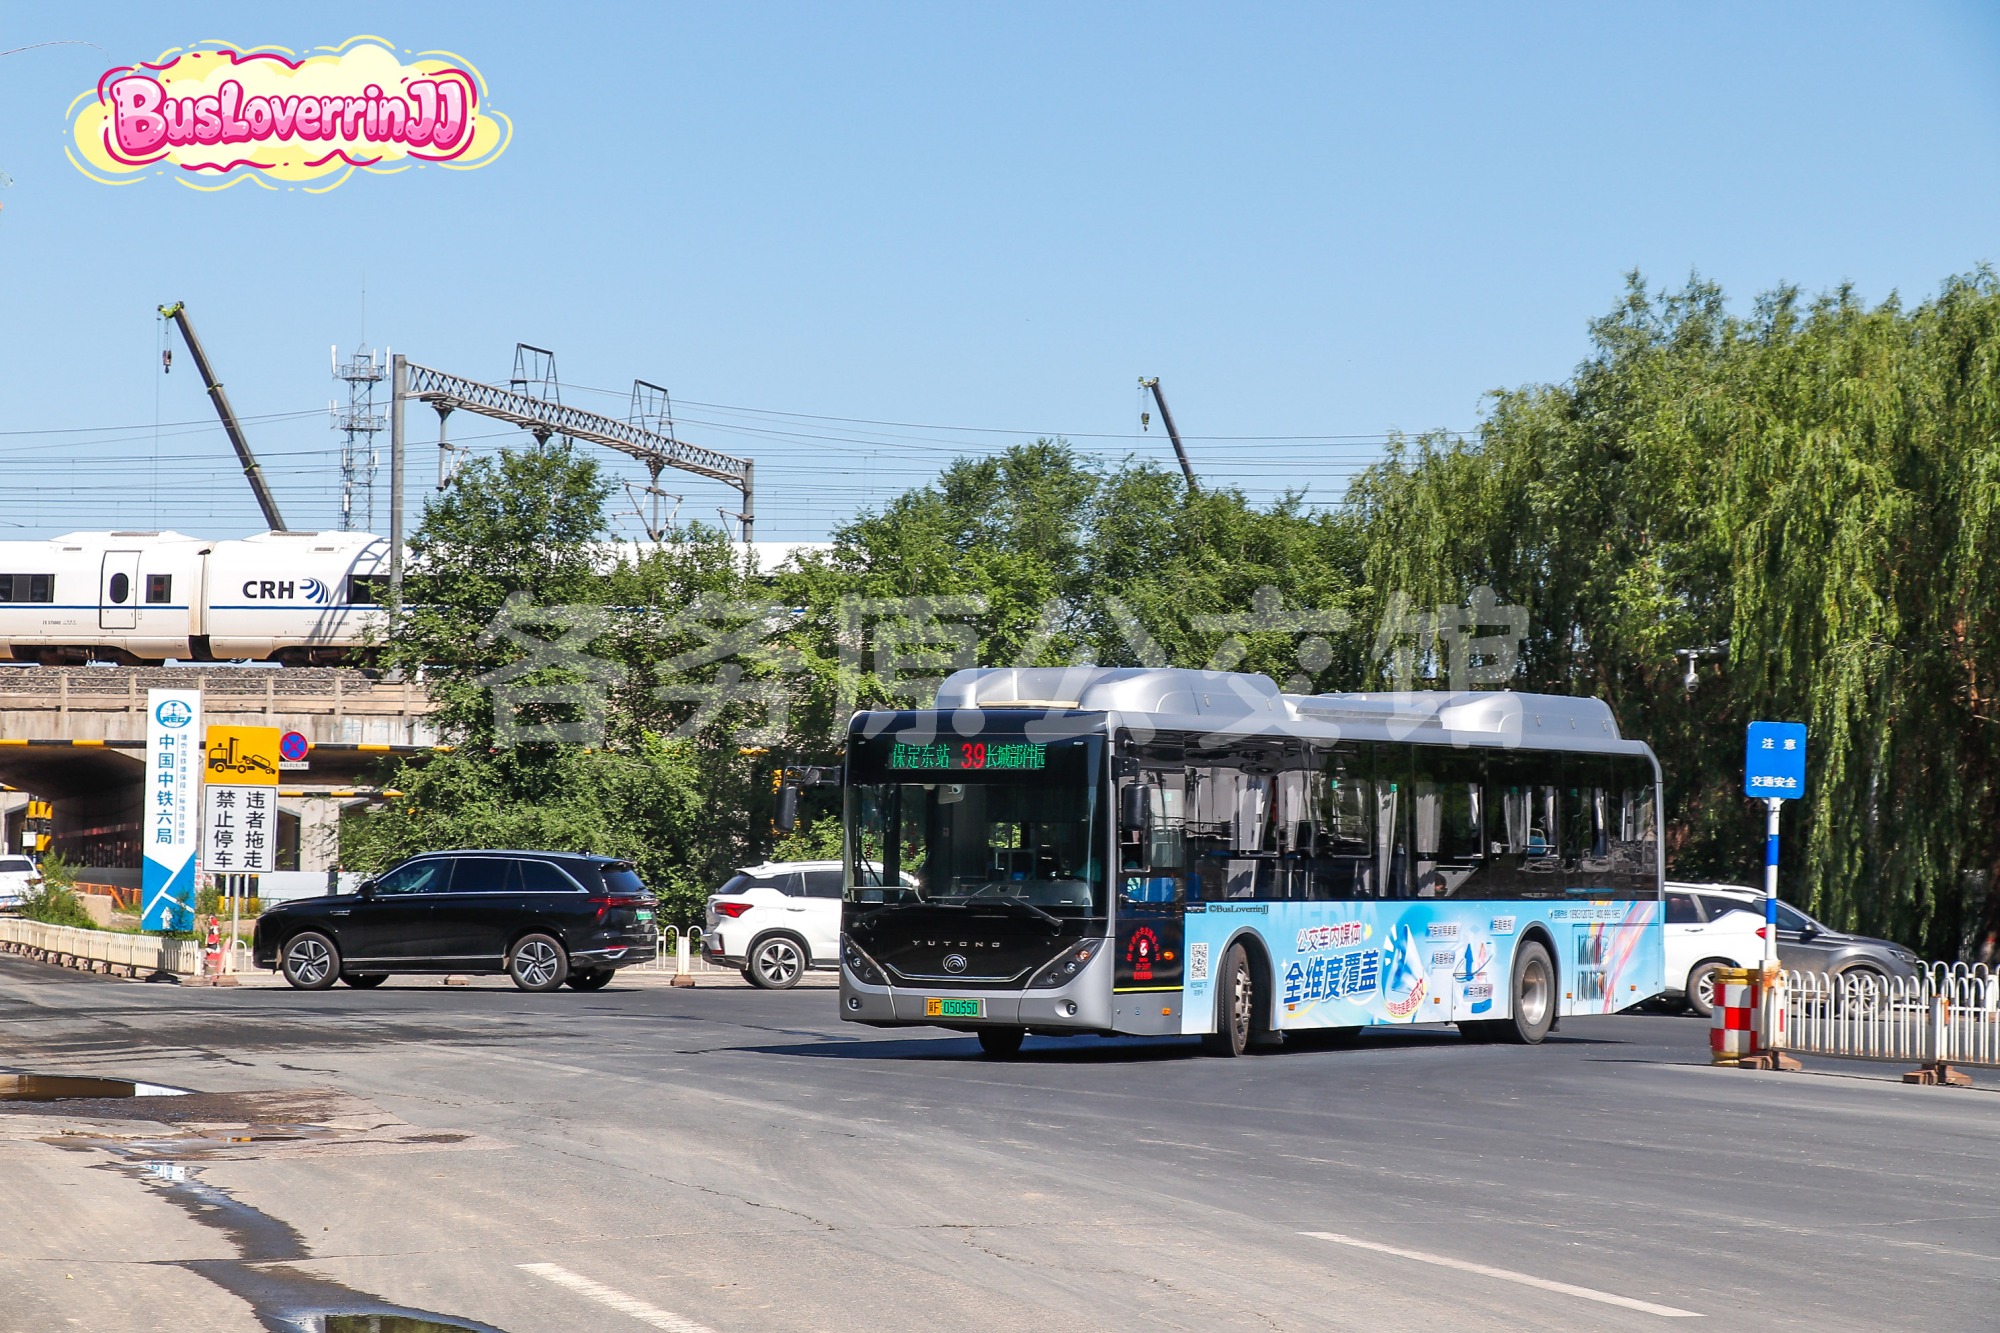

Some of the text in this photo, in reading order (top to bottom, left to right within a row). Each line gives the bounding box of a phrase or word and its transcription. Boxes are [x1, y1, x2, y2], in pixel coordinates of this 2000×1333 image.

[242, 580, 294, 600] CRH
[892, 743, 951, 769] 保定东站
[960, 742, 985, 769] 39
[1761, 737, 1797, 750] 注意
[156, 733, 174, 845] 中国中铁六局
[1751, 775, 1797, 788] 交通安全
[213, 790, 236, 868] 禁止停车
[243, 790, 266, 869] 违者拖走
[912, 940, 1001, 948] YUTONG
[1296, 922, 1361, 953] 公交车内媒体
[1284, 951, 1379, 1004] 全维度覆盖
